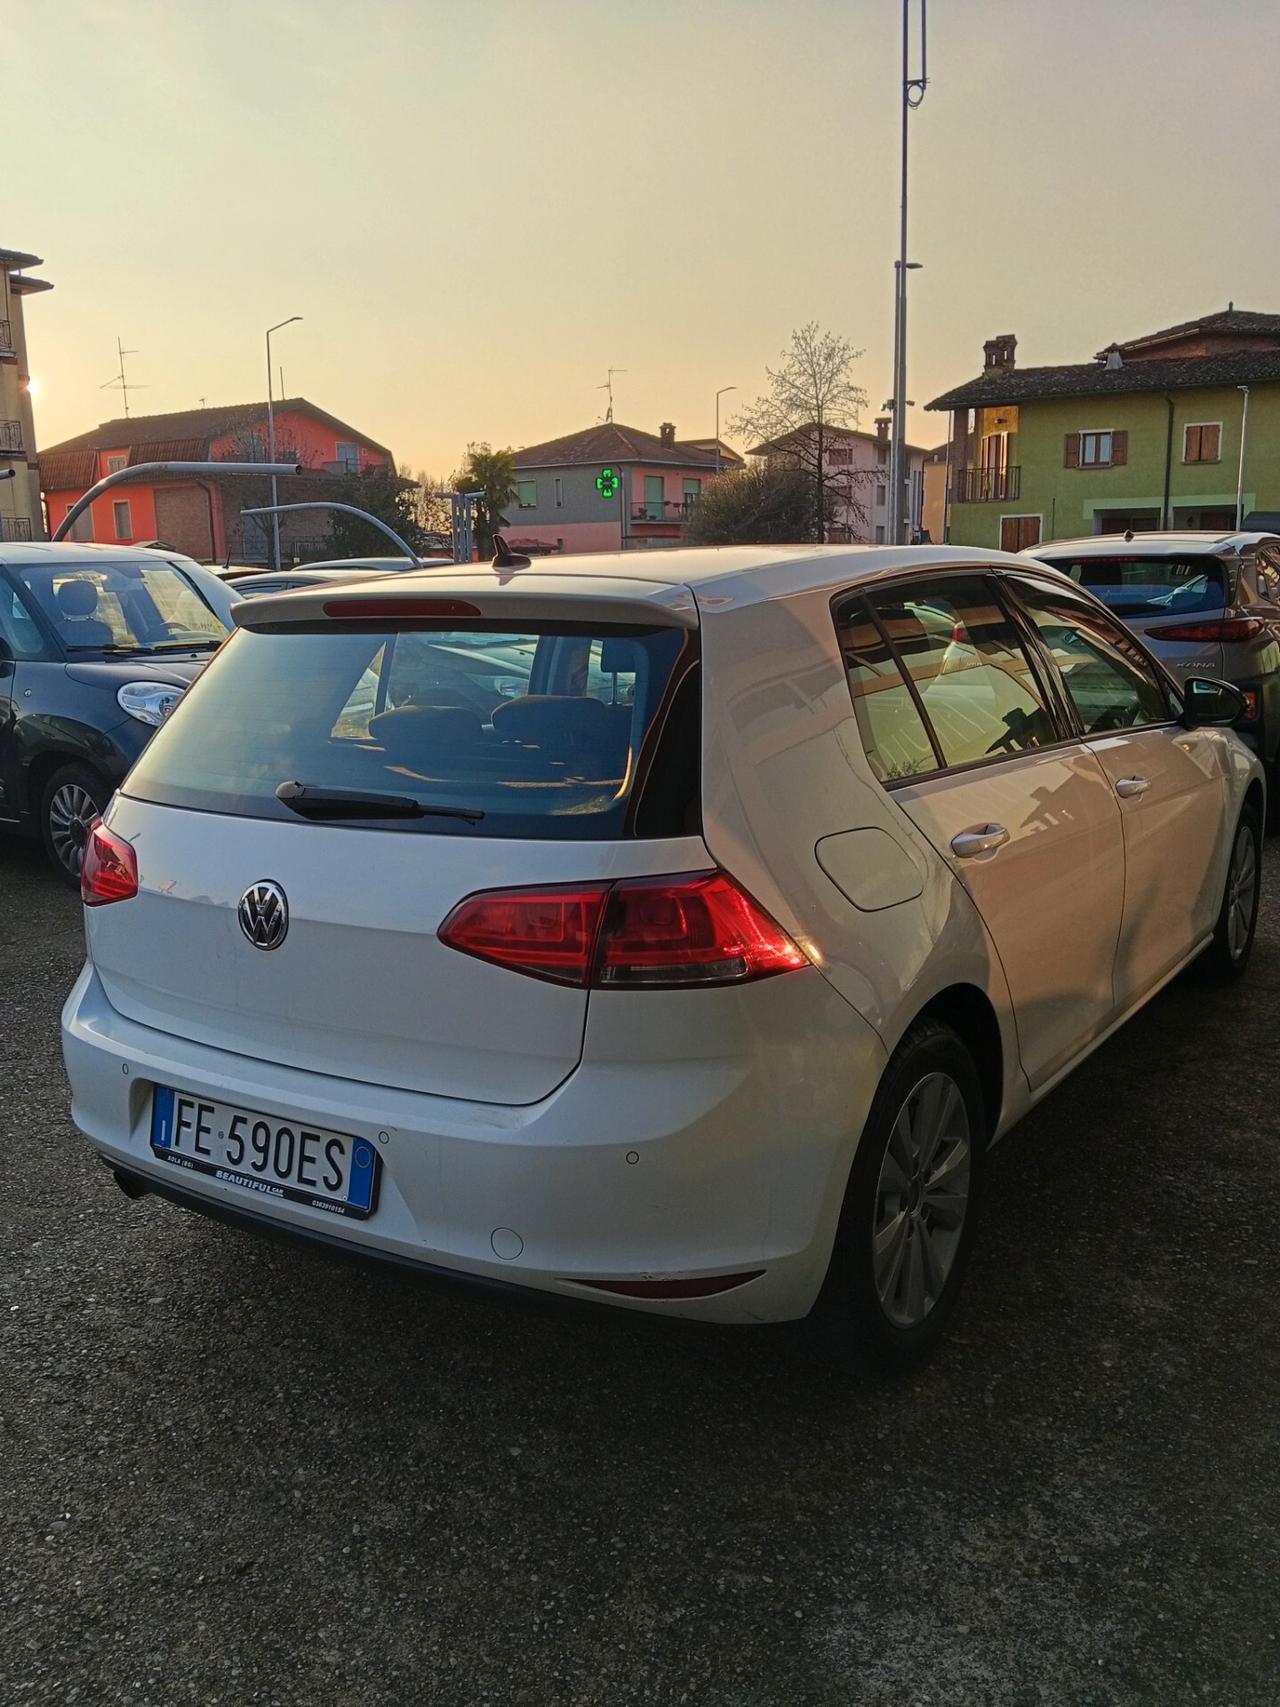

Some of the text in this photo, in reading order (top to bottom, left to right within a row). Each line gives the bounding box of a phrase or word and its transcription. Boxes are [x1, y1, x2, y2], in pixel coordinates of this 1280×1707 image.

[240, 881, 286, 948] VW
[175, 1097, 345, 1192] FE 590ES
[215, 1170, 275, 1194] BEAUTIFUL
